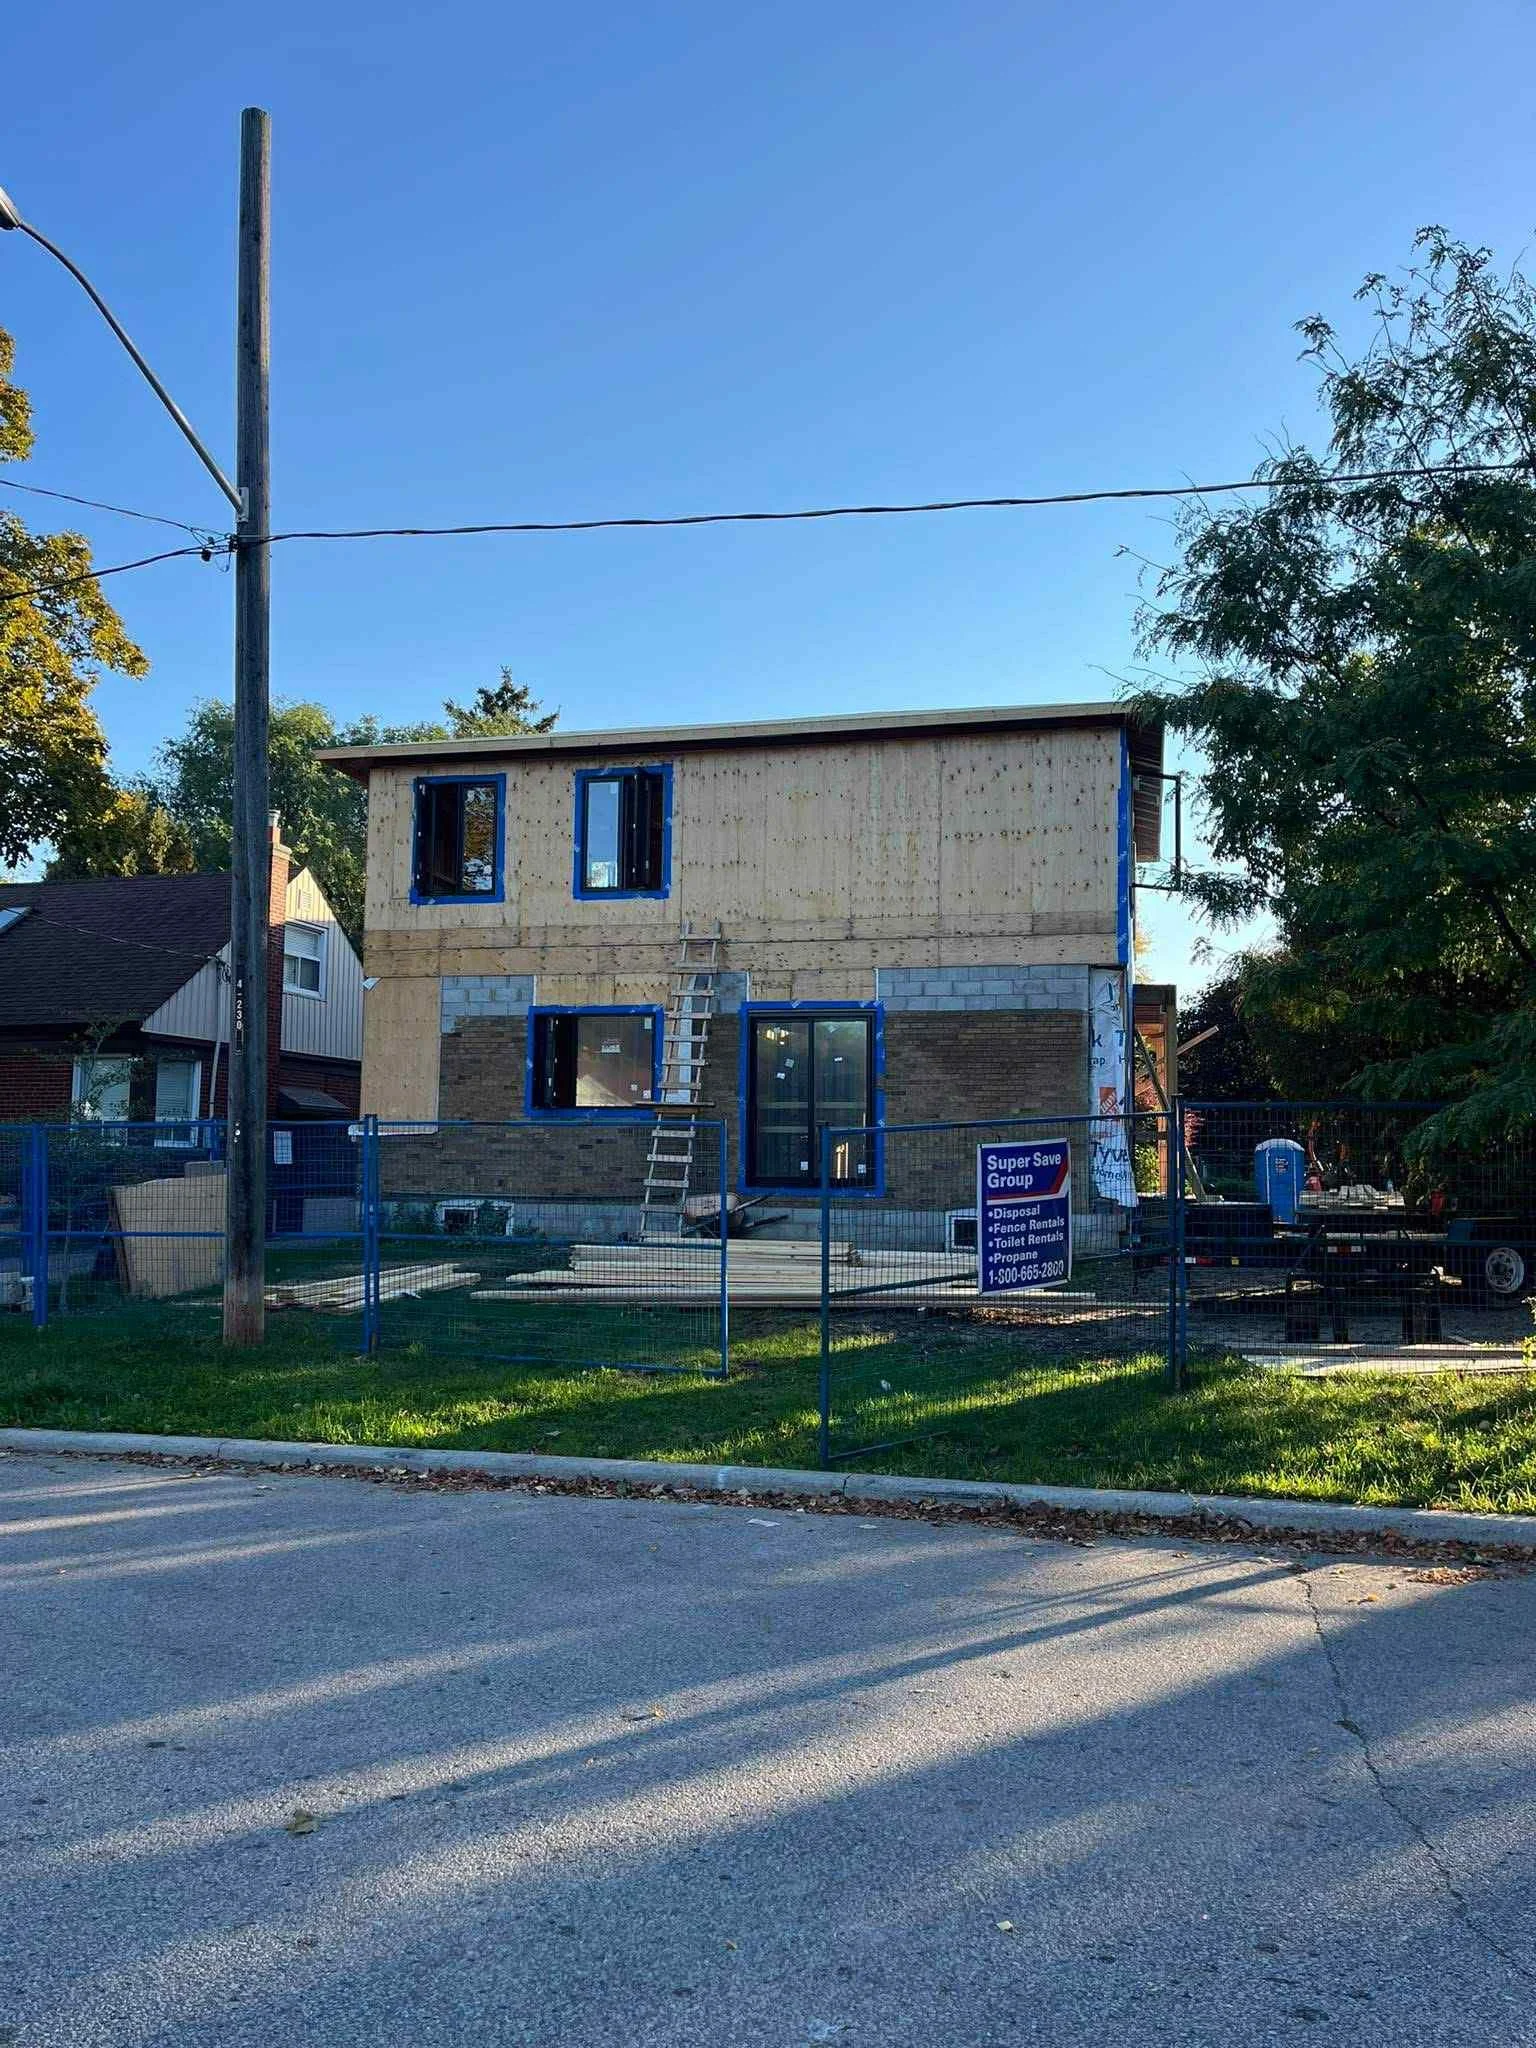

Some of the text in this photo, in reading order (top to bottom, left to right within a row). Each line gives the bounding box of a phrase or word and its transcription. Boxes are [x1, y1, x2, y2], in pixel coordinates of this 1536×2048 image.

[1091, 1141, 1129, 1164] Tyve
[987, 1152, 1061, 1173] Super Save
[987, 1172, 1034, 1189] Group
[993, 1204, 1040, 1220] Disposal
[993, 1216, 1065, 1234] Fence Rentals
[994, 1230, 1064, 1249] Toilet Rentals
[993, 1251, 1038, 1264] Propane
[988, 1260, 1064, 1285] 1-800-665-2800
